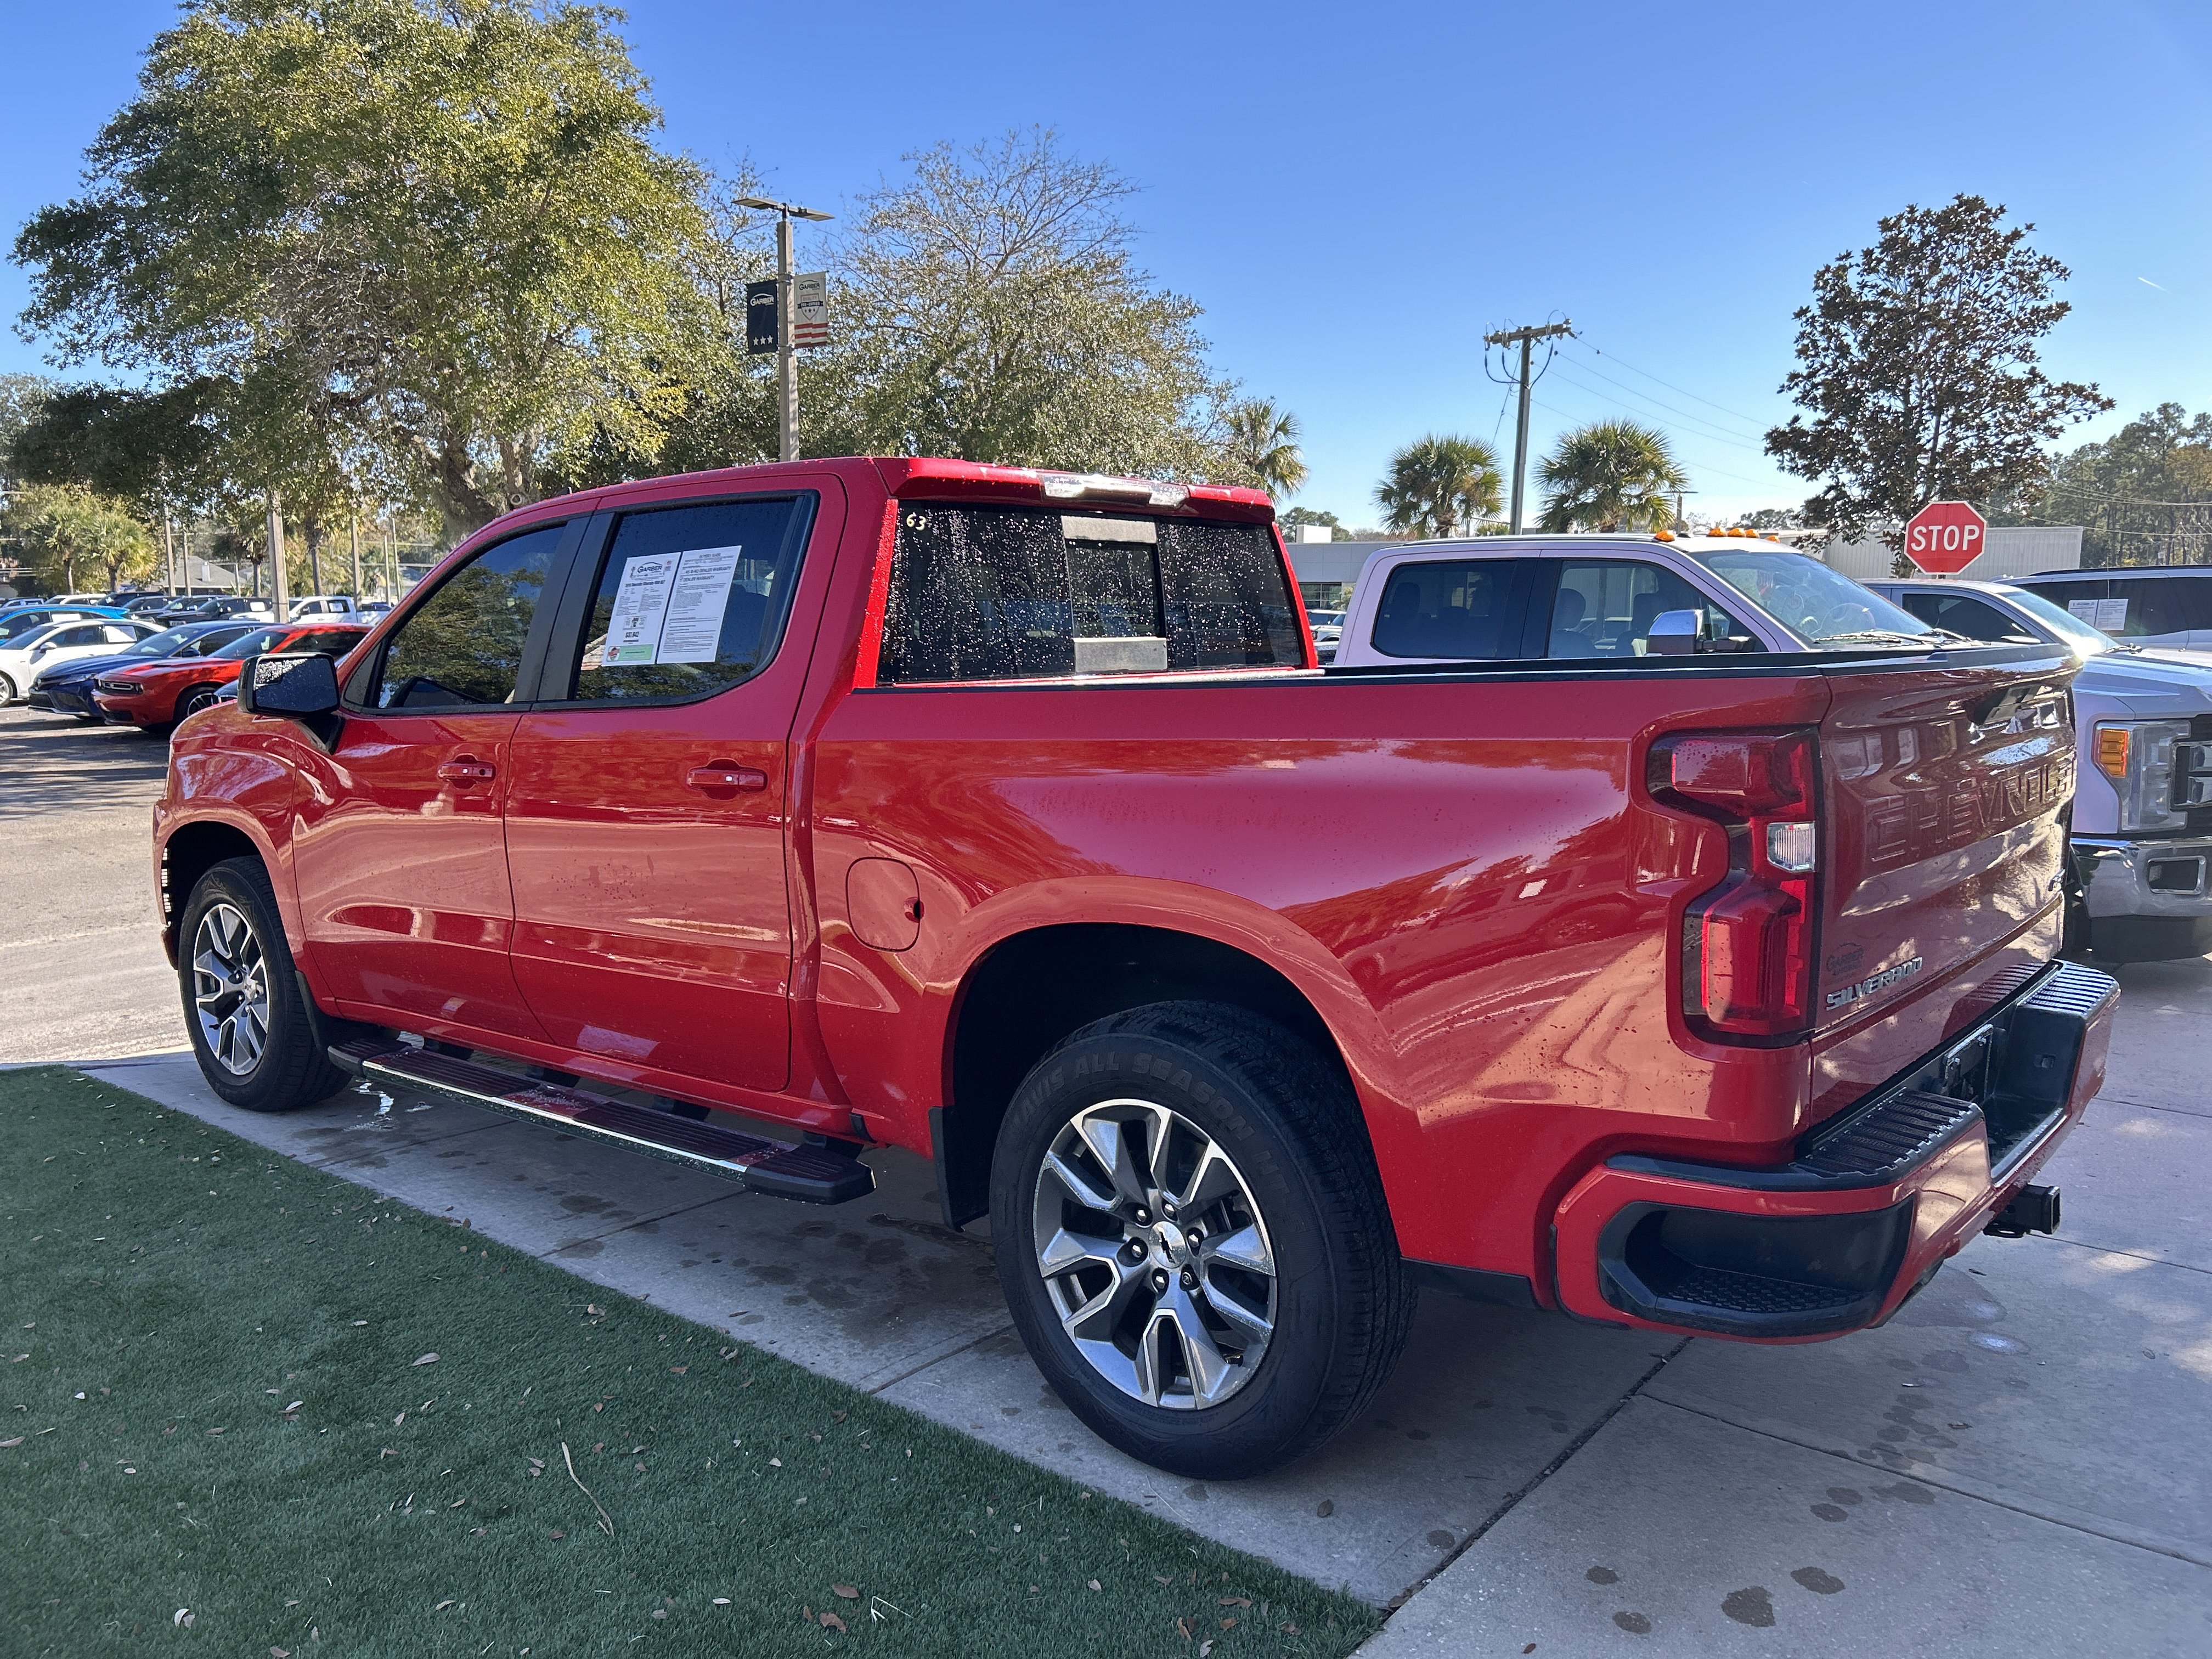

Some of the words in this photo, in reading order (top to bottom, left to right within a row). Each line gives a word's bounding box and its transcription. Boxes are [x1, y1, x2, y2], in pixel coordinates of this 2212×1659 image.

[750, 296, 774, 307] GARBER
[906, 512, 926, 531] 63
[1910, 524, 1980, 551] STOP
[1826, 956, 1922, 1012] SILVERADO
[1073, 1050, 1119, 1079] ALL
[1131, 1052, 1256, 1142] SEASON
